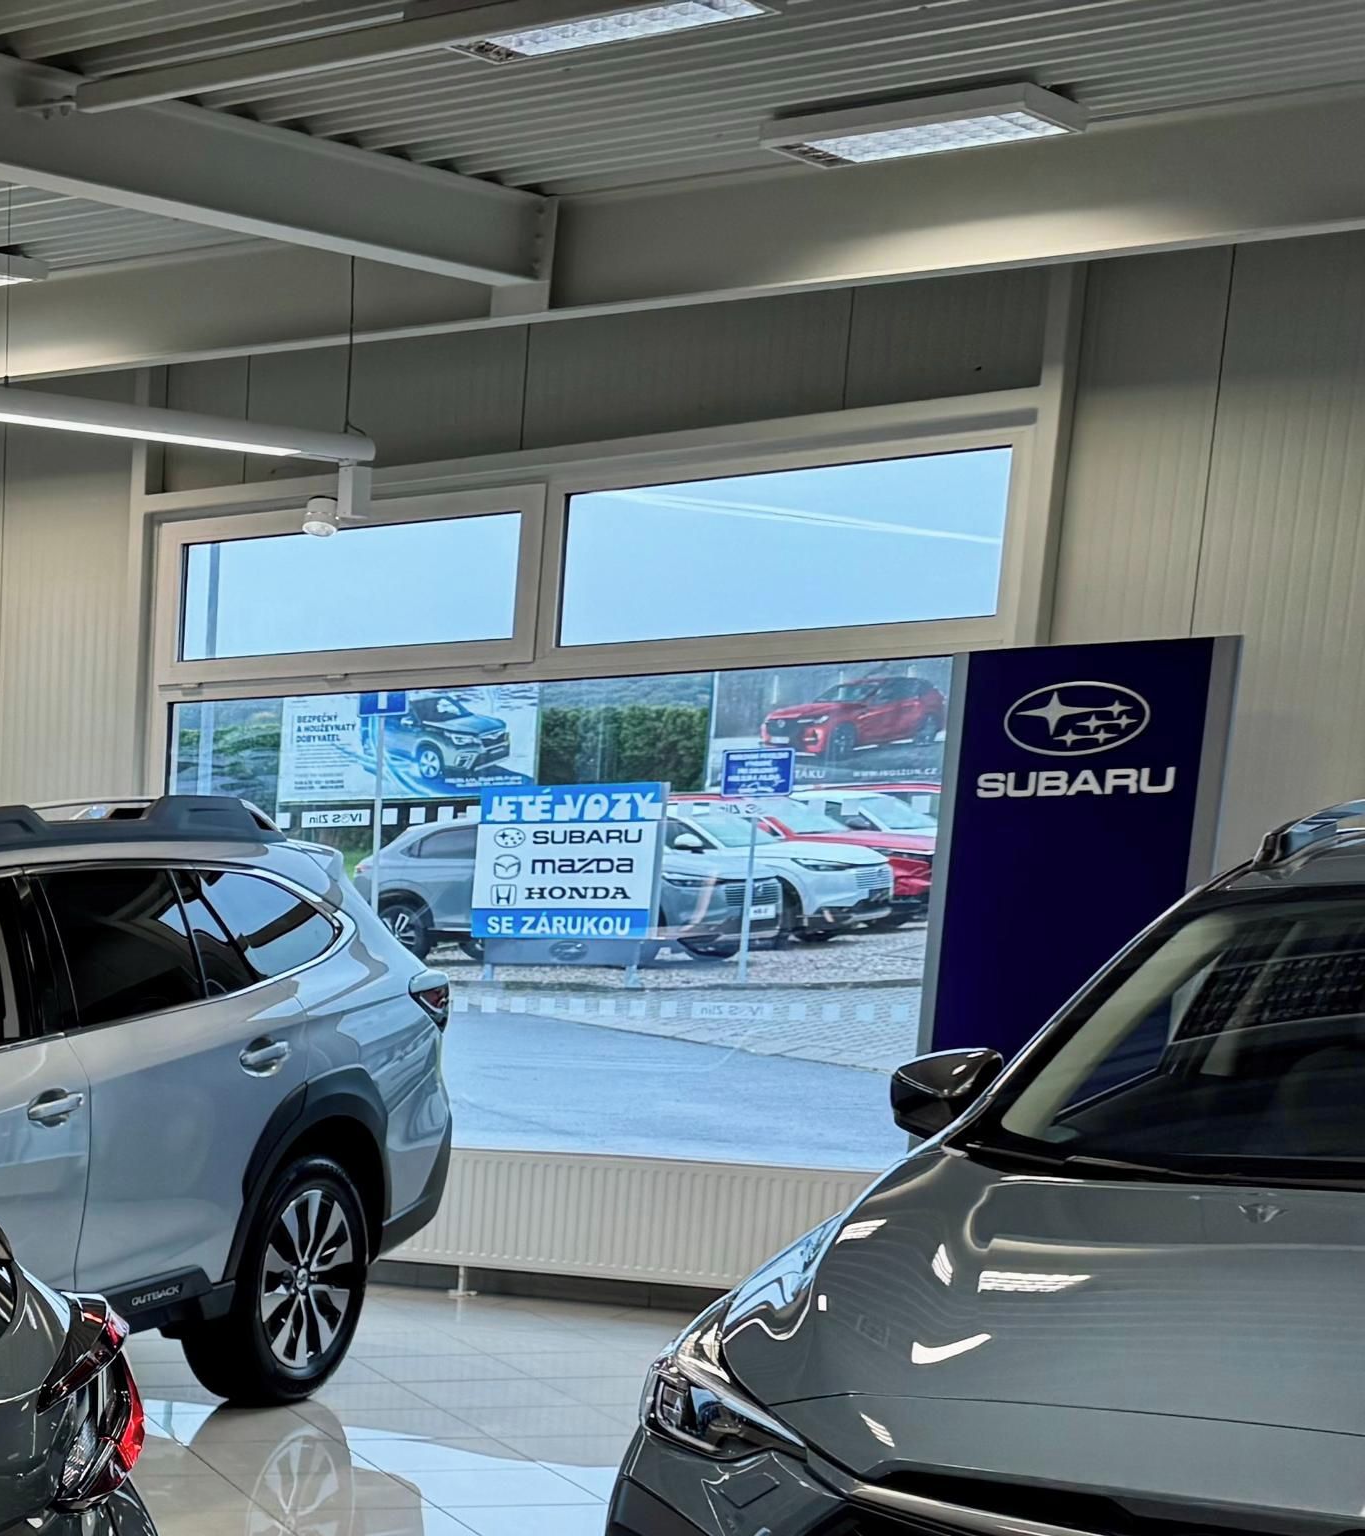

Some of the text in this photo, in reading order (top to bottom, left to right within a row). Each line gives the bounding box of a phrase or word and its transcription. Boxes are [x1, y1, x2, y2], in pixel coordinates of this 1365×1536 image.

[976, 766, 1176, 798] SUBARU
[561, 791, 657, 821] VOZY
[532, 829, 643, 845] SUBARU
[525, 886, 631, 900] HONDA
[487, 912, 631, 935] SE ZÁRUKOU
[131, 1285, 181, 1306] OUTBACK
